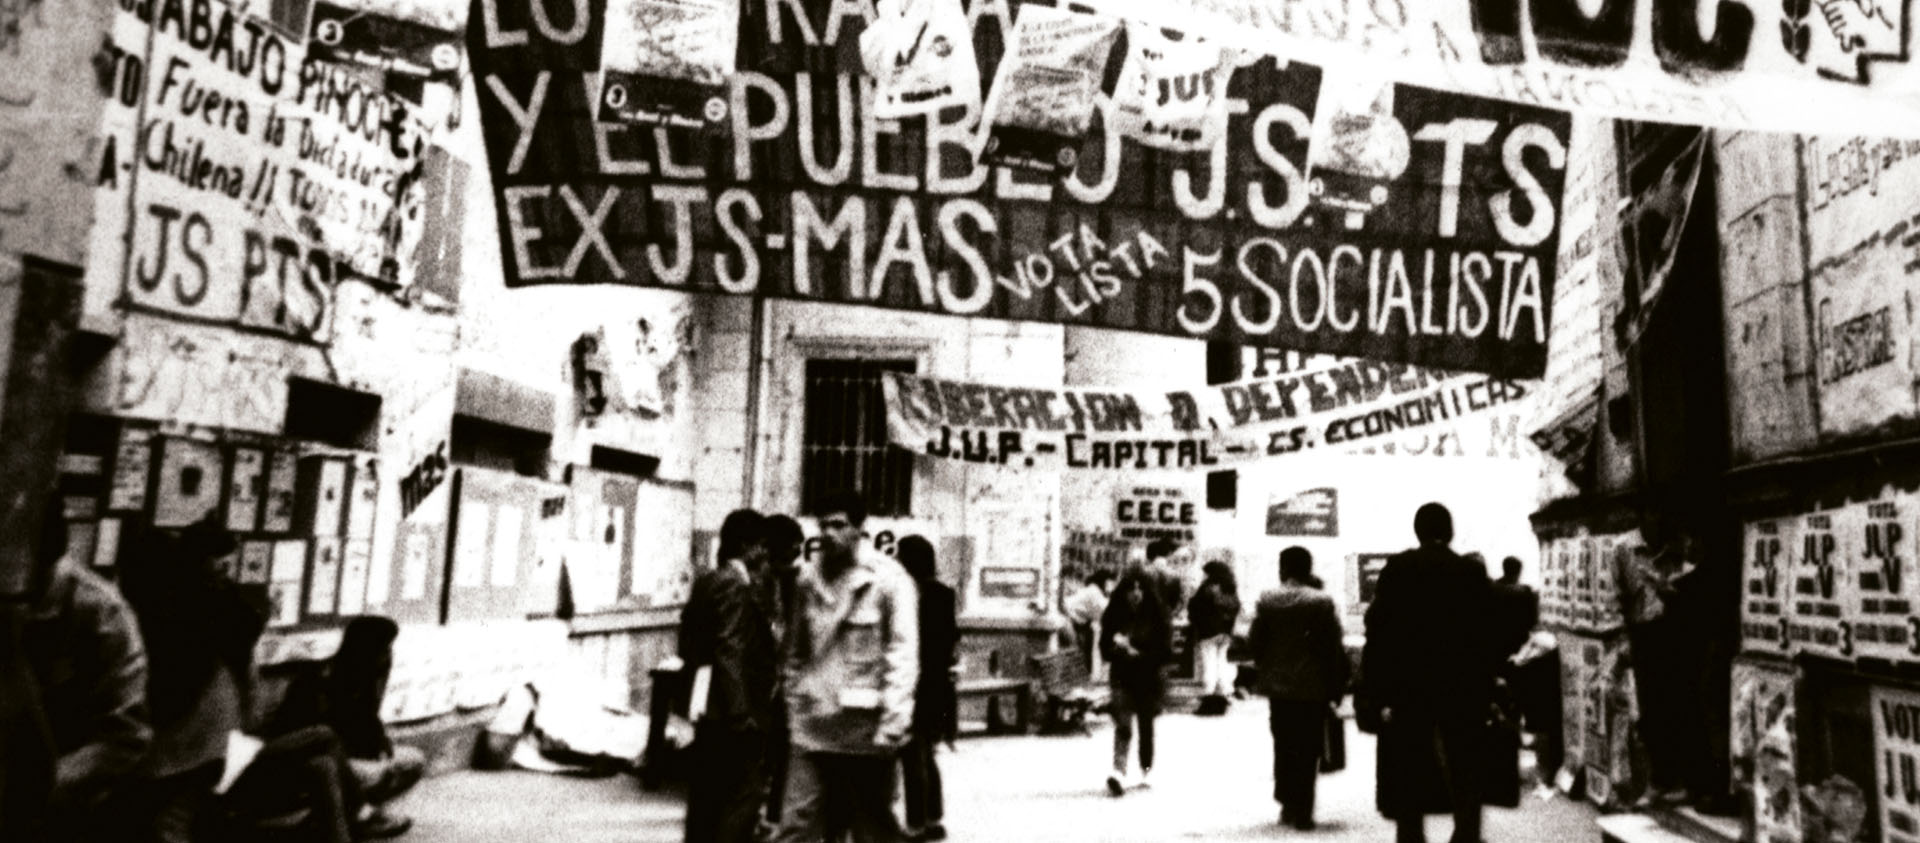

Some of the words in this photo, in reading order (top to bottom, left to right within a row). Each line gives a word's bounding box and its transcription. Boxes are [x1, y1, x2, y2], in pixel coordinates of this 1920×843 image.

[158, 0, 286, 96] ABAJO
[157, 56, 250, 136] Fuera
[264, 103, 286, 148] la
[486, 70, 551, 175] Y
[145, 118, 245, 199] Chilena
[136, 204, 213, 306] JS
[240, 229, 334, 336] PTS
[504, 185, 626, 279] EX
[646, 185, 999, 314] JS-MAS
[998, 221, 1106, 300] VOTA
[1055, 229, 1170, 316] LISTA
[1176, 246, 1223, 334] 5
[1231, 237, 1546, 345] SOCIALISTA
[1065, 432, 1219, 470] CAPITAL
[1323, 377, 1526, 446] ECONOMICAS
[1801, 532, 1836, 567] JUP
[1862, 521, 1903, 561] JUP
